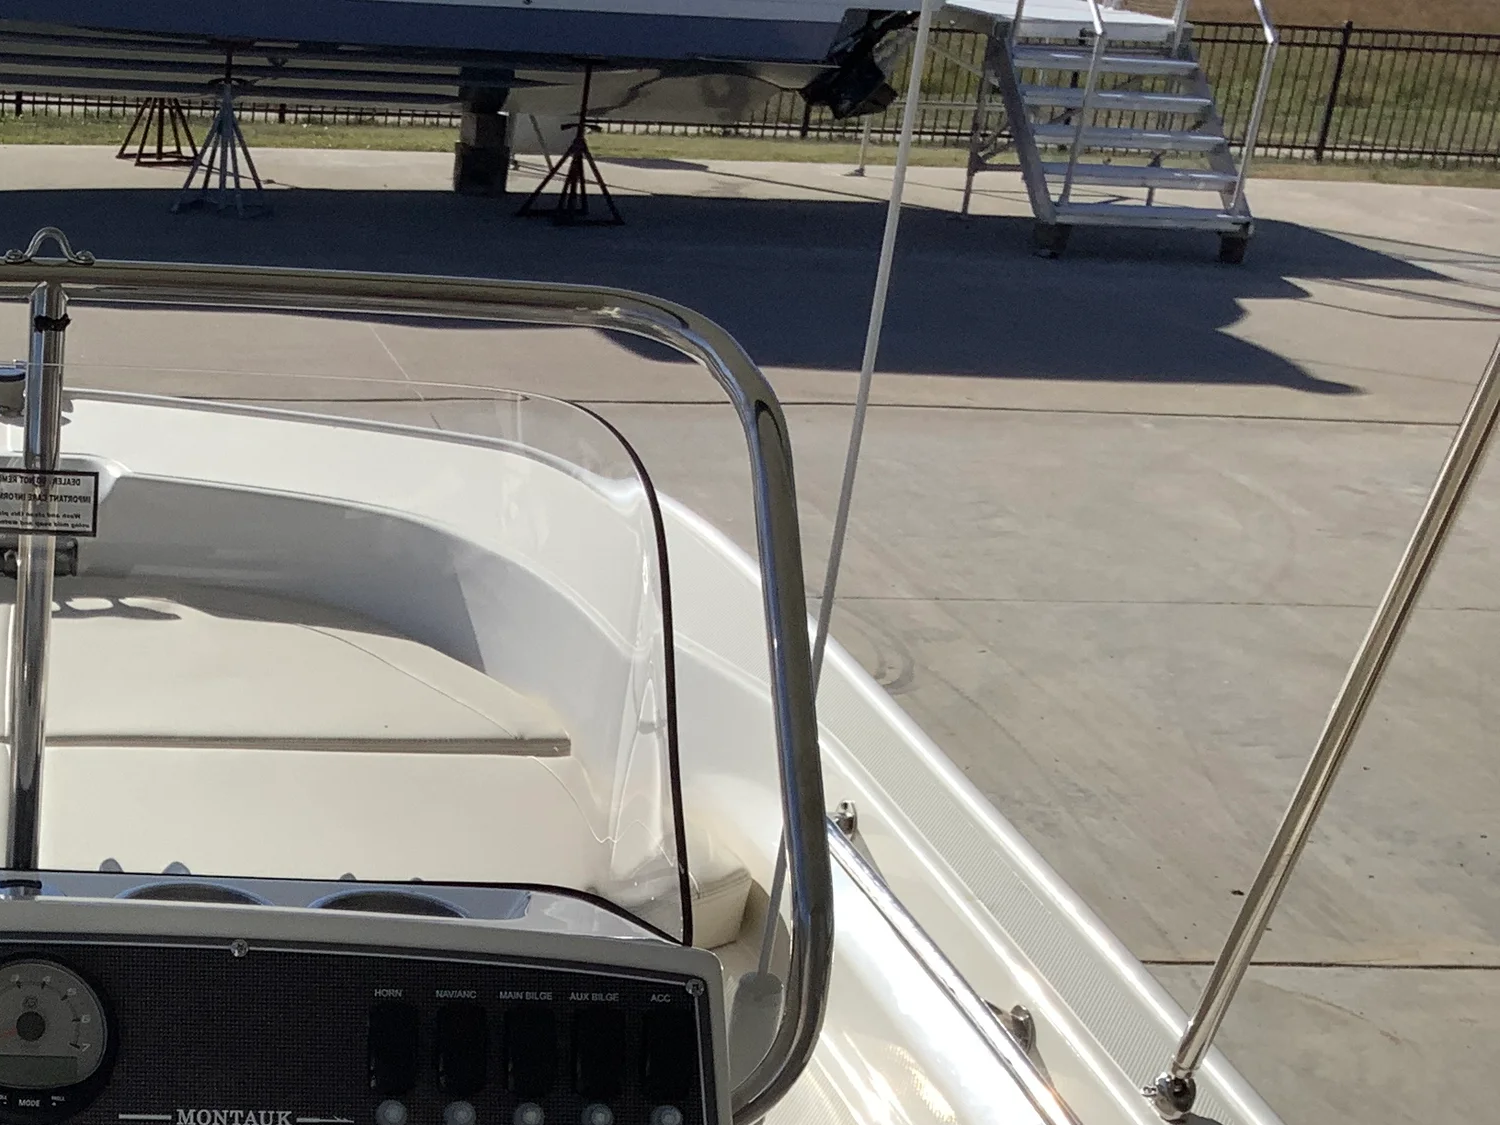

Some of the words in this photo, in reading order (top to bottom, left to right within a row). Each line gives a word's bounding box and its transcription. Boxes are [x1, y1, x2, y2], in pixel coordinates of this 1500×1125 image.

[374, 989, 402, 997] HORN
[500, 991, 524, 999] MAIN
[526, 992, 552, 1000] BILGE
[18, 1099, 40, 1107] MODE
